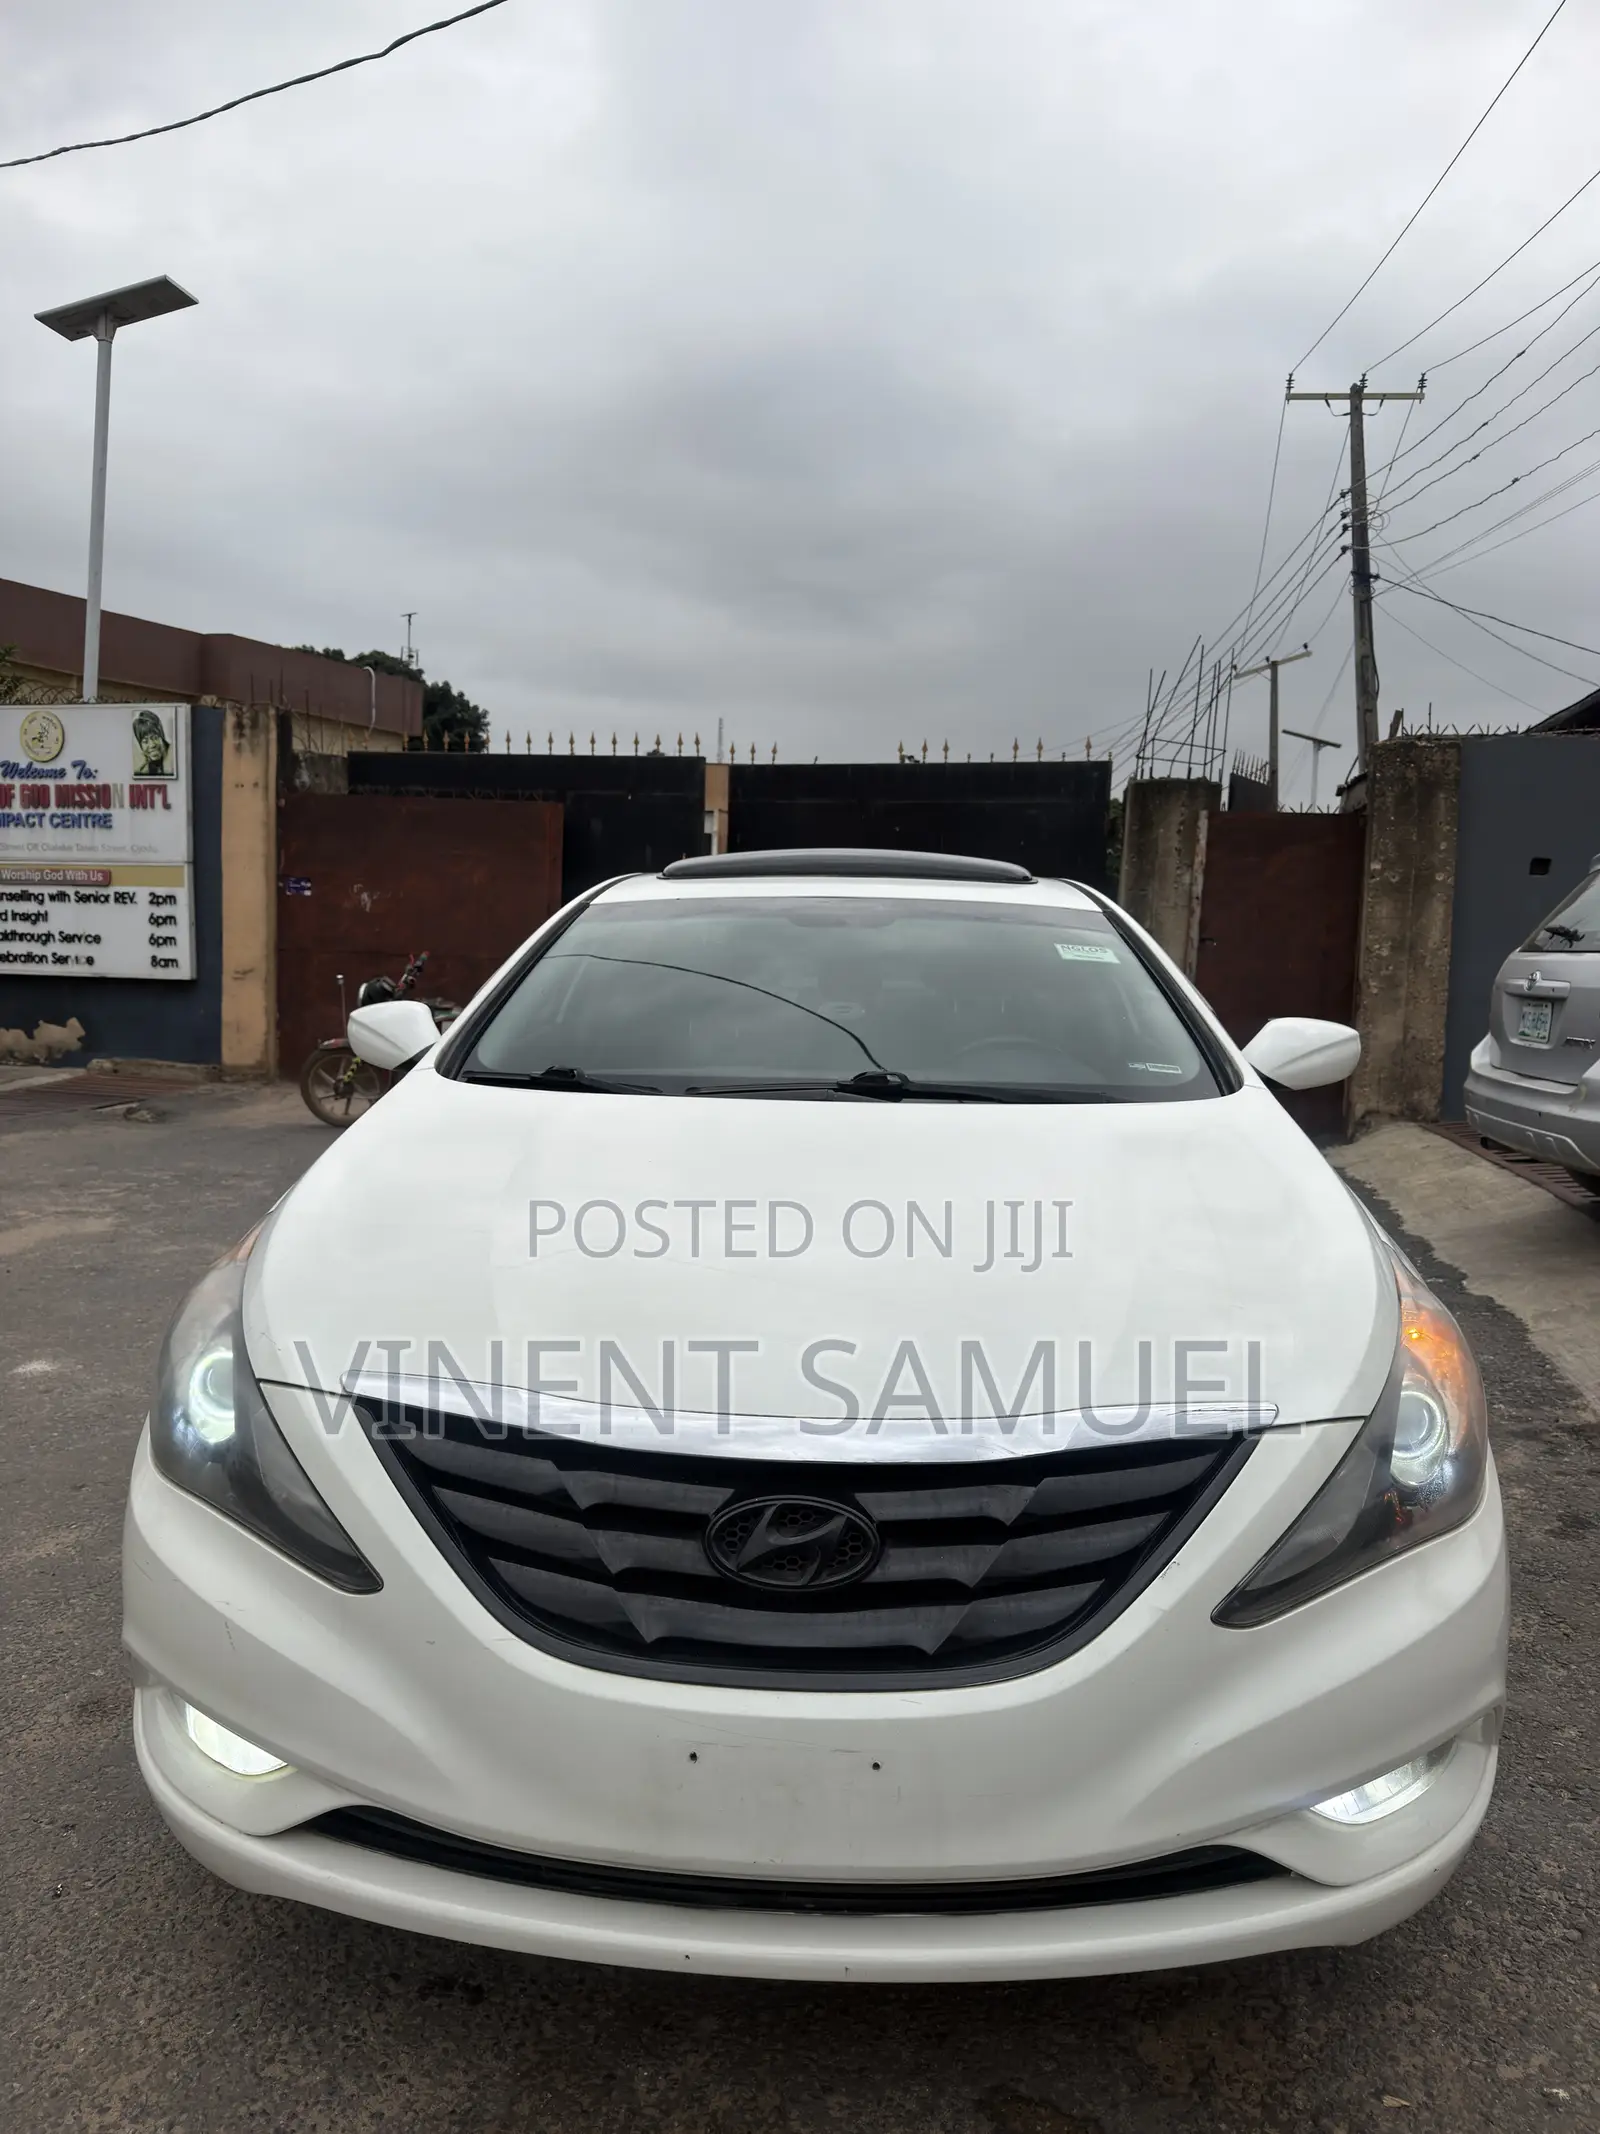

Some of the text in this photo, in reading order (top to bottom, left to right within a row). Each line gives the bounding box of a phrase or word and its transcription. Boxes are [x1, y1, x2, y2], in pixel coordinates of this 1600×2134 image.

[0, 760, 98, 779] Welcome To:
[19, 783, 50, 810] GOD
[54, 783, 124, 810] MISSION
[49, 812, 113, 830] CENTRE
[1, 868, 104, 882] Worship God With Us
[47, 890, 71, 903] with
[74, 890, 110, 904] Senior
[114, 891, 138, 905] REV.
[148, 892, 177, 907] 2pm
[11, 909, 48, 925] Insight
[148, 912, 177, 927] 6pm
[58, 930, 102, 944] Service
[148, 933, 177, 947] 6pm
[151, 955, 179, 969] 8am
